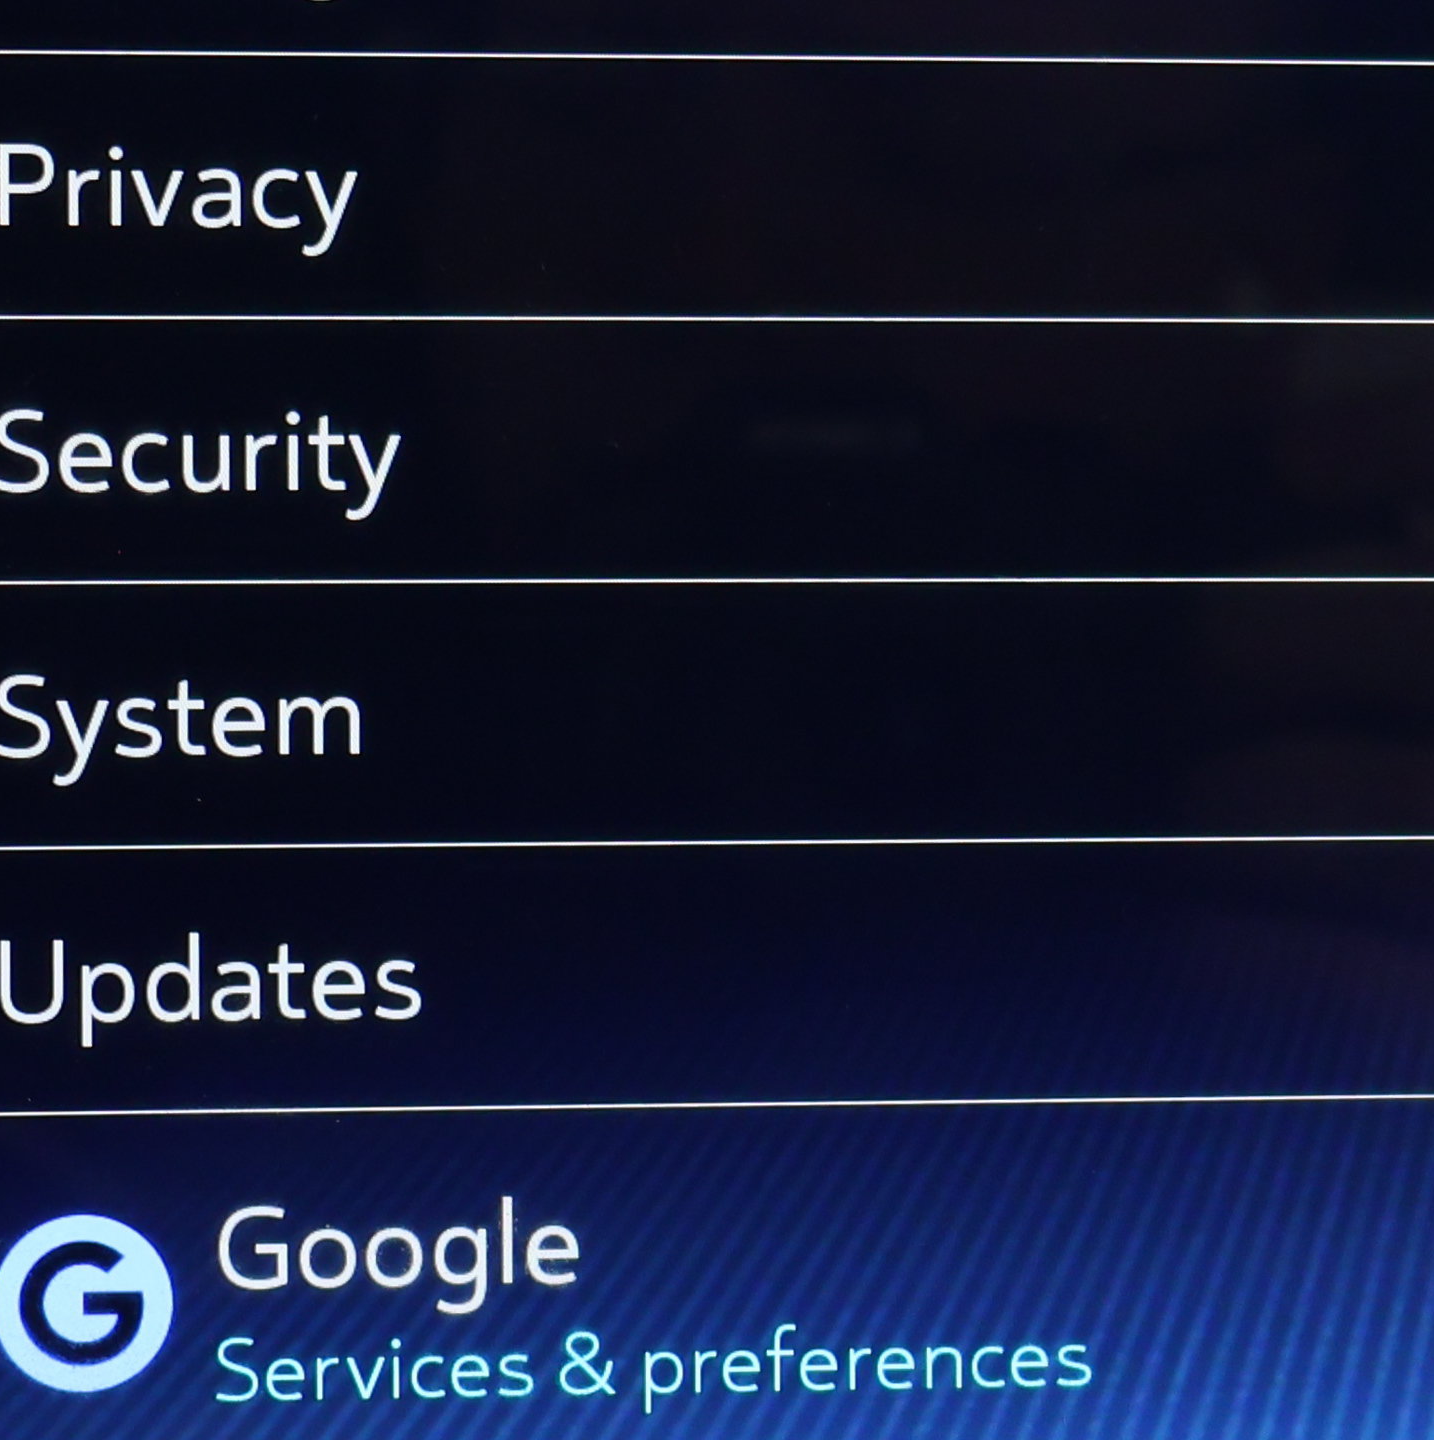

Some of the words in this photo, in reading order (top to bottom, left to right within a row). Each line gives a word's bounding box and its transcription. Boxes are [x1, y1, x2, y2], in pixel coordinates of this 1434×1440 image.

[0, 931, 423, 1048] Updates
[218, 1195, 580, 1315] Google
[216, 1337, 535, 1402] Services
[559, 1331, 616, 1396] &
[644, 1323, 1093, 1413] preferences
